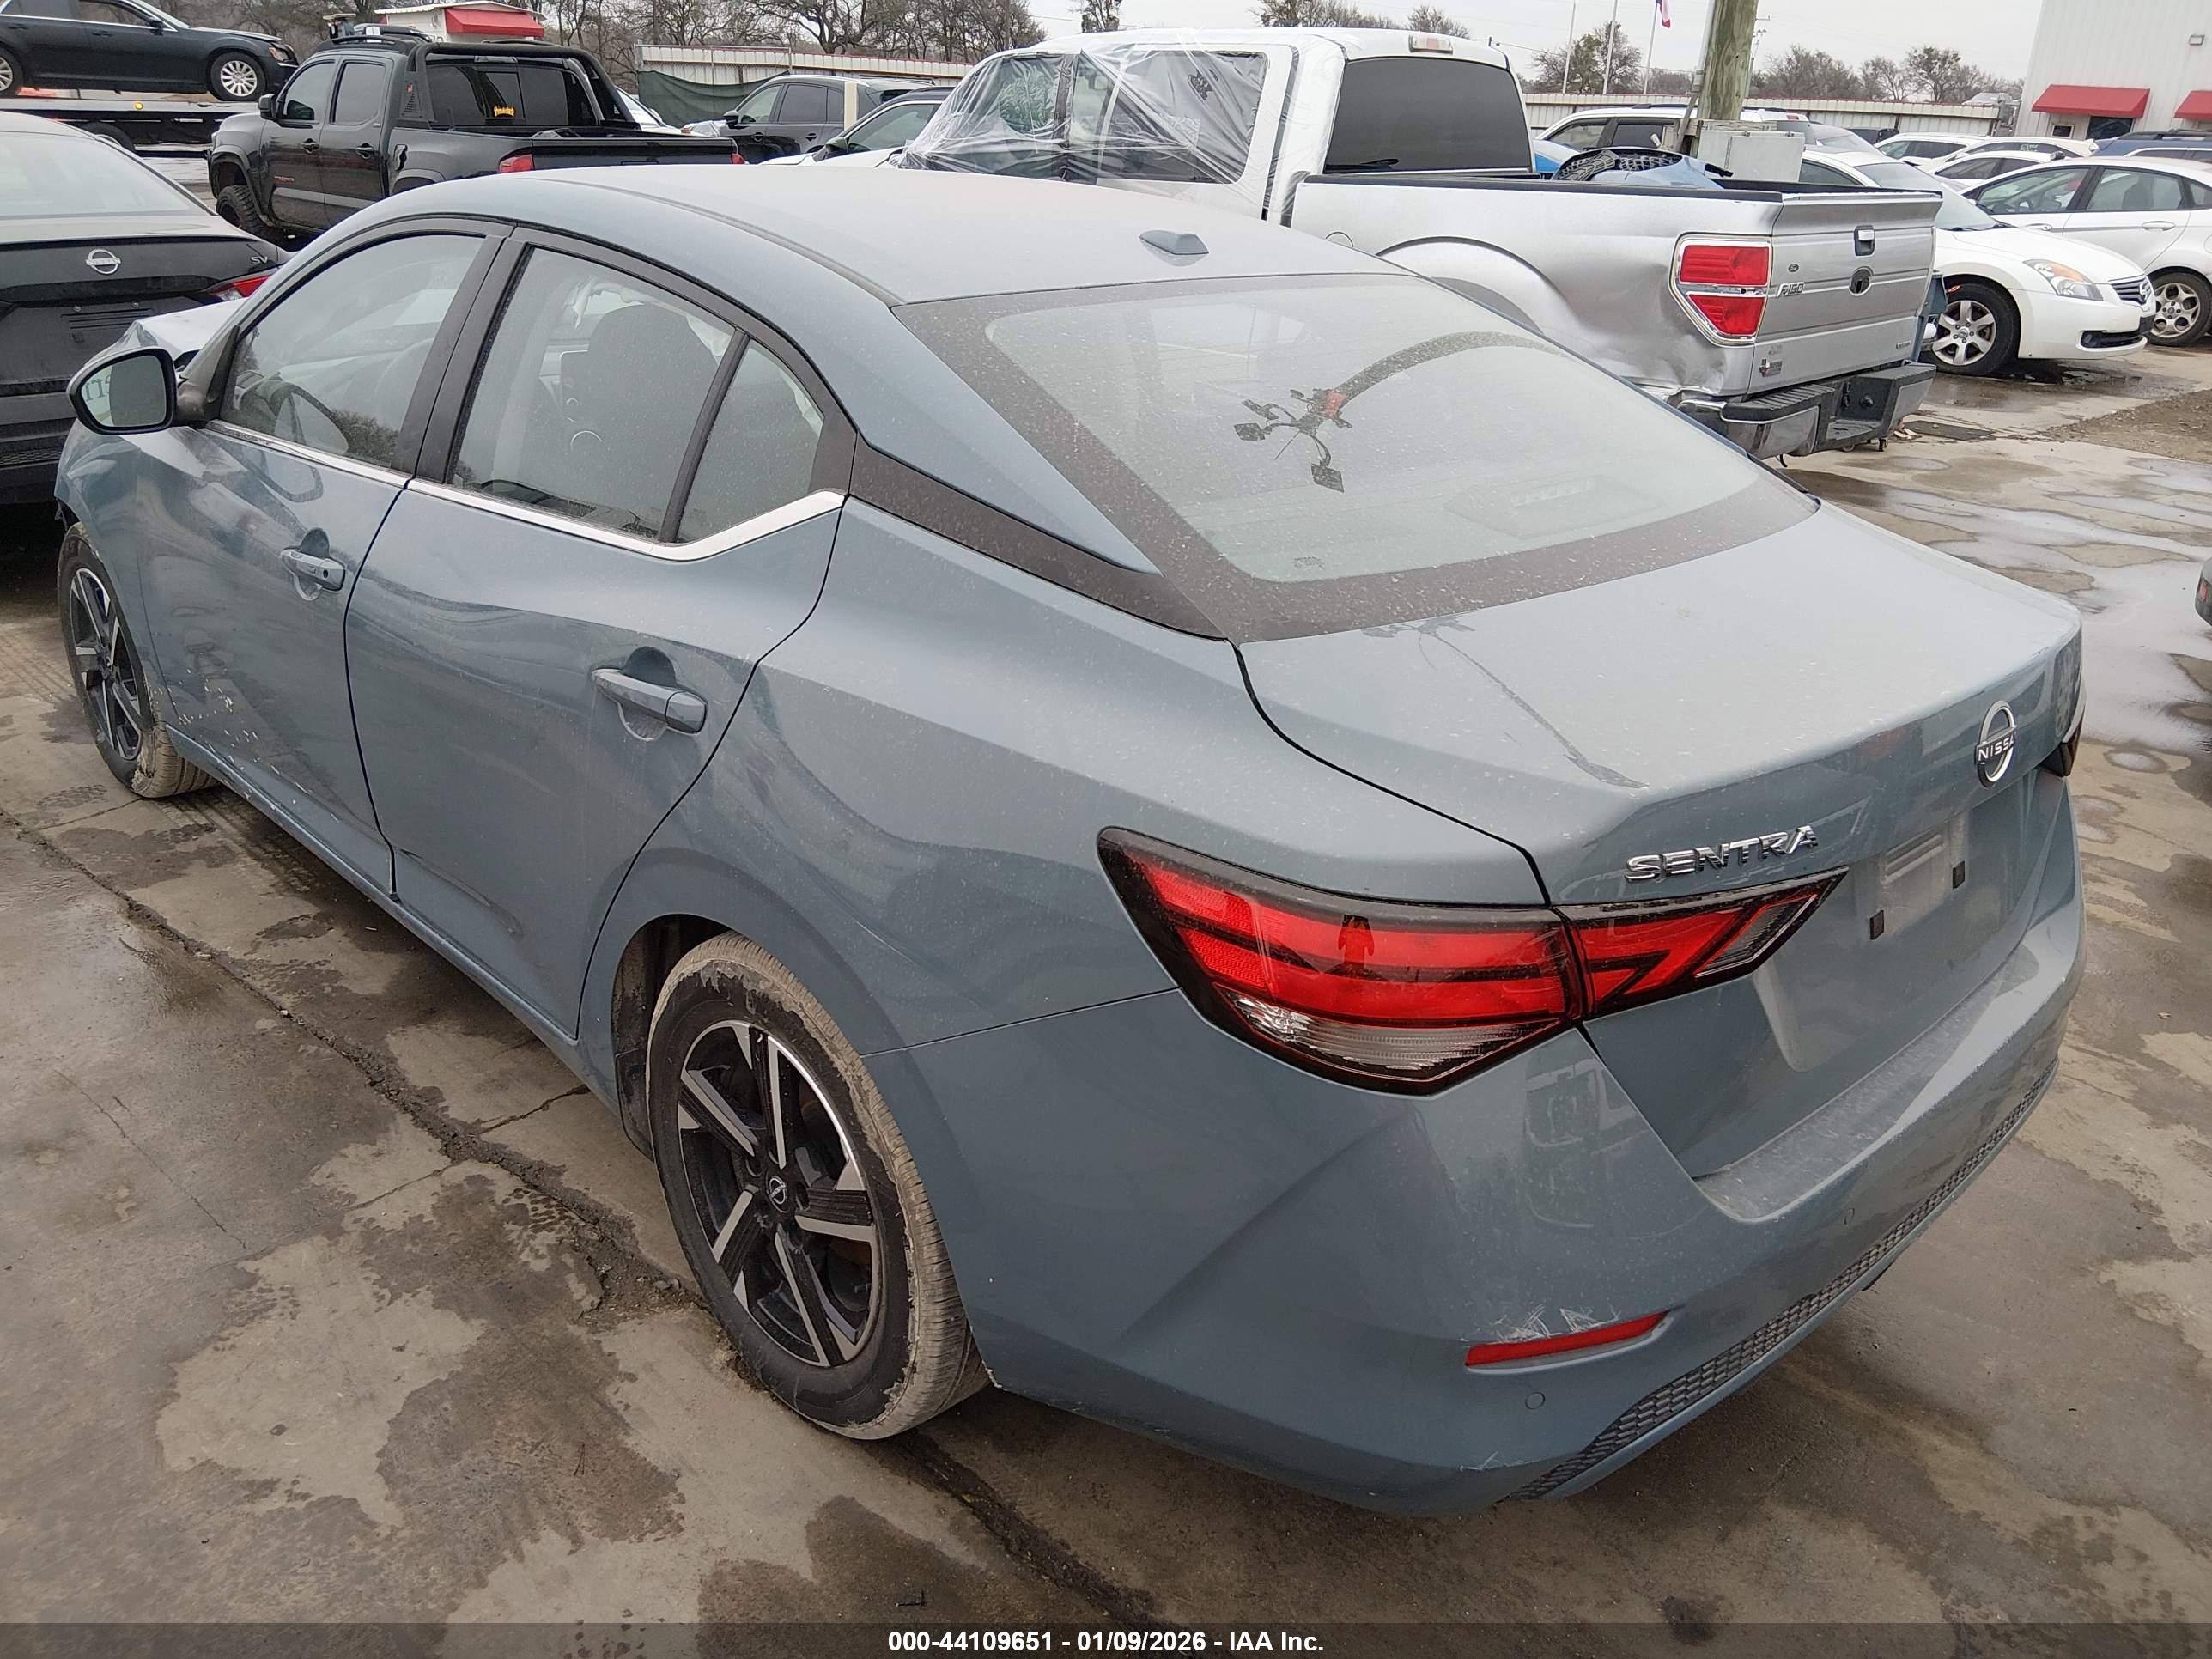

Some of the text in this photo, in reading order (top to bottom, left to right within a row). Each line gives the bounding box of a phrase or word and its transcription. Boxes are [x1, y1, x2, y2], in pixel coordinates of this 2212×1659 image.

[250, 256, 268, 264] SV
[1978, 732, 2015, 762] NISSA
[1624, 825, 1819, 884] SENTRA
